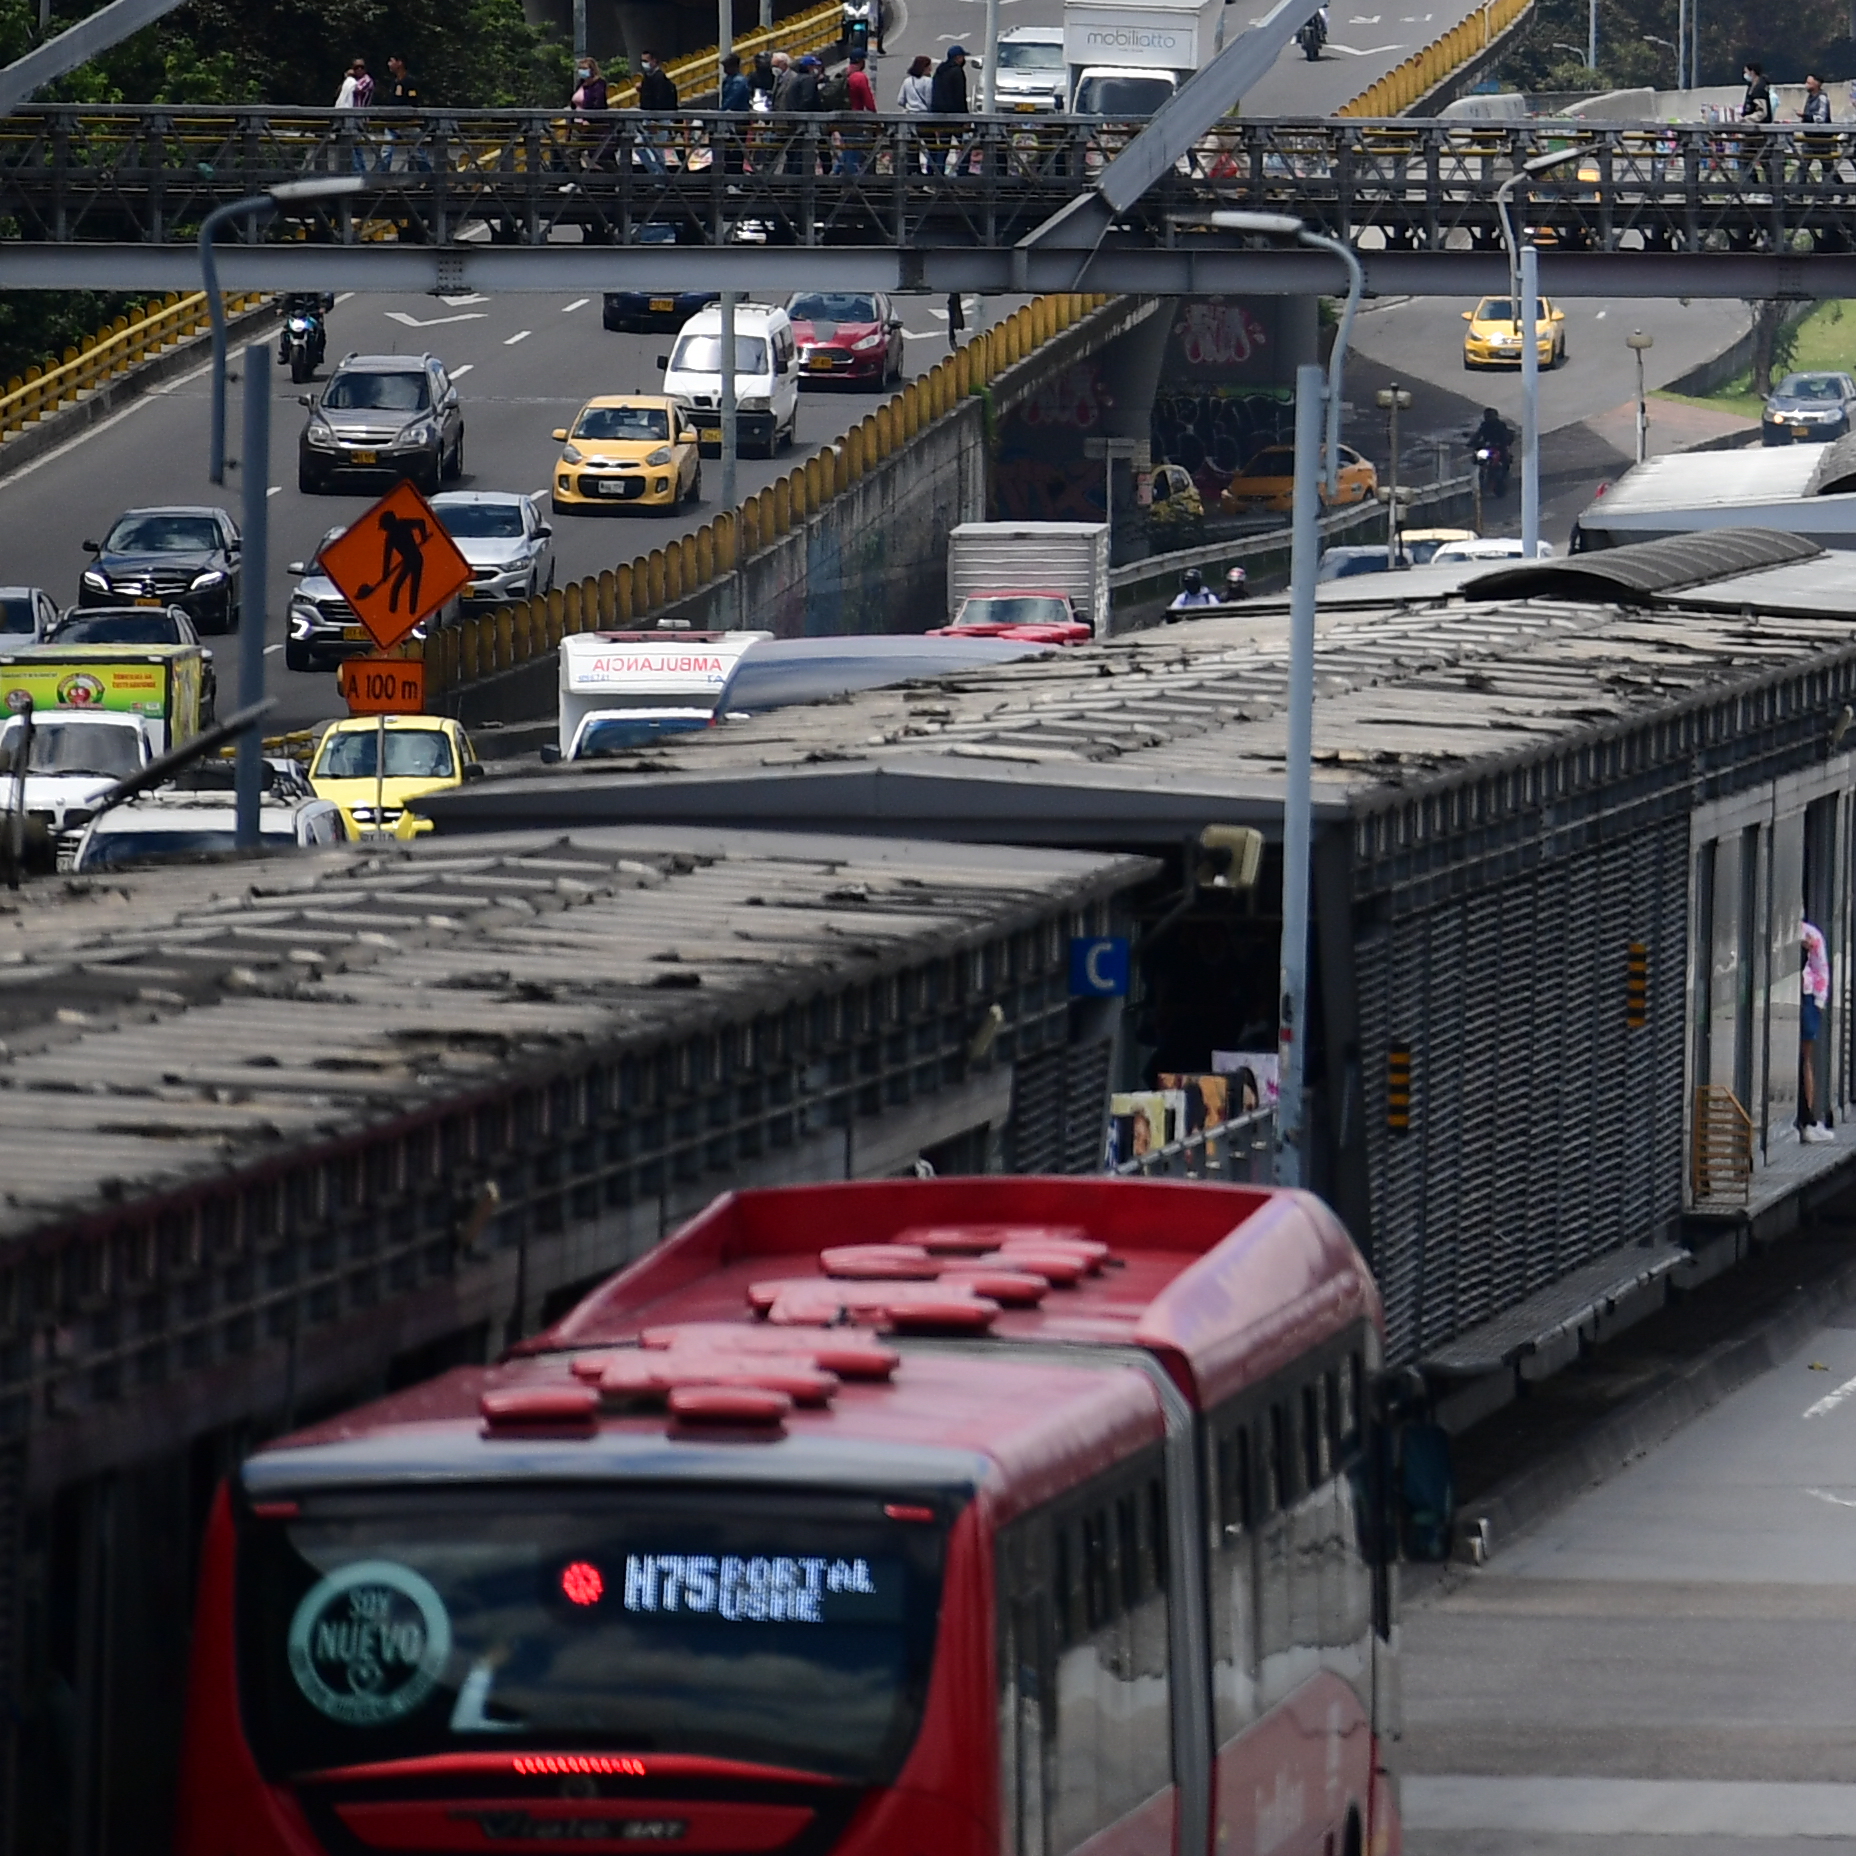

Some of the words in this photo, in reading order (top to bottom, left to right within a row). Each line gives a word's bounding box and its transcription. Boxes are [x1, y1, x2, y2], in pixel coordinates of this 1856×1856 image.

[348, 675, 359, 700] A
[366, 673, 395, 700] 100
[399, 680, 418, 700] m
[1086, 942, 1114, 989] C
[316, 1620, 422, 1663] NUEVO
